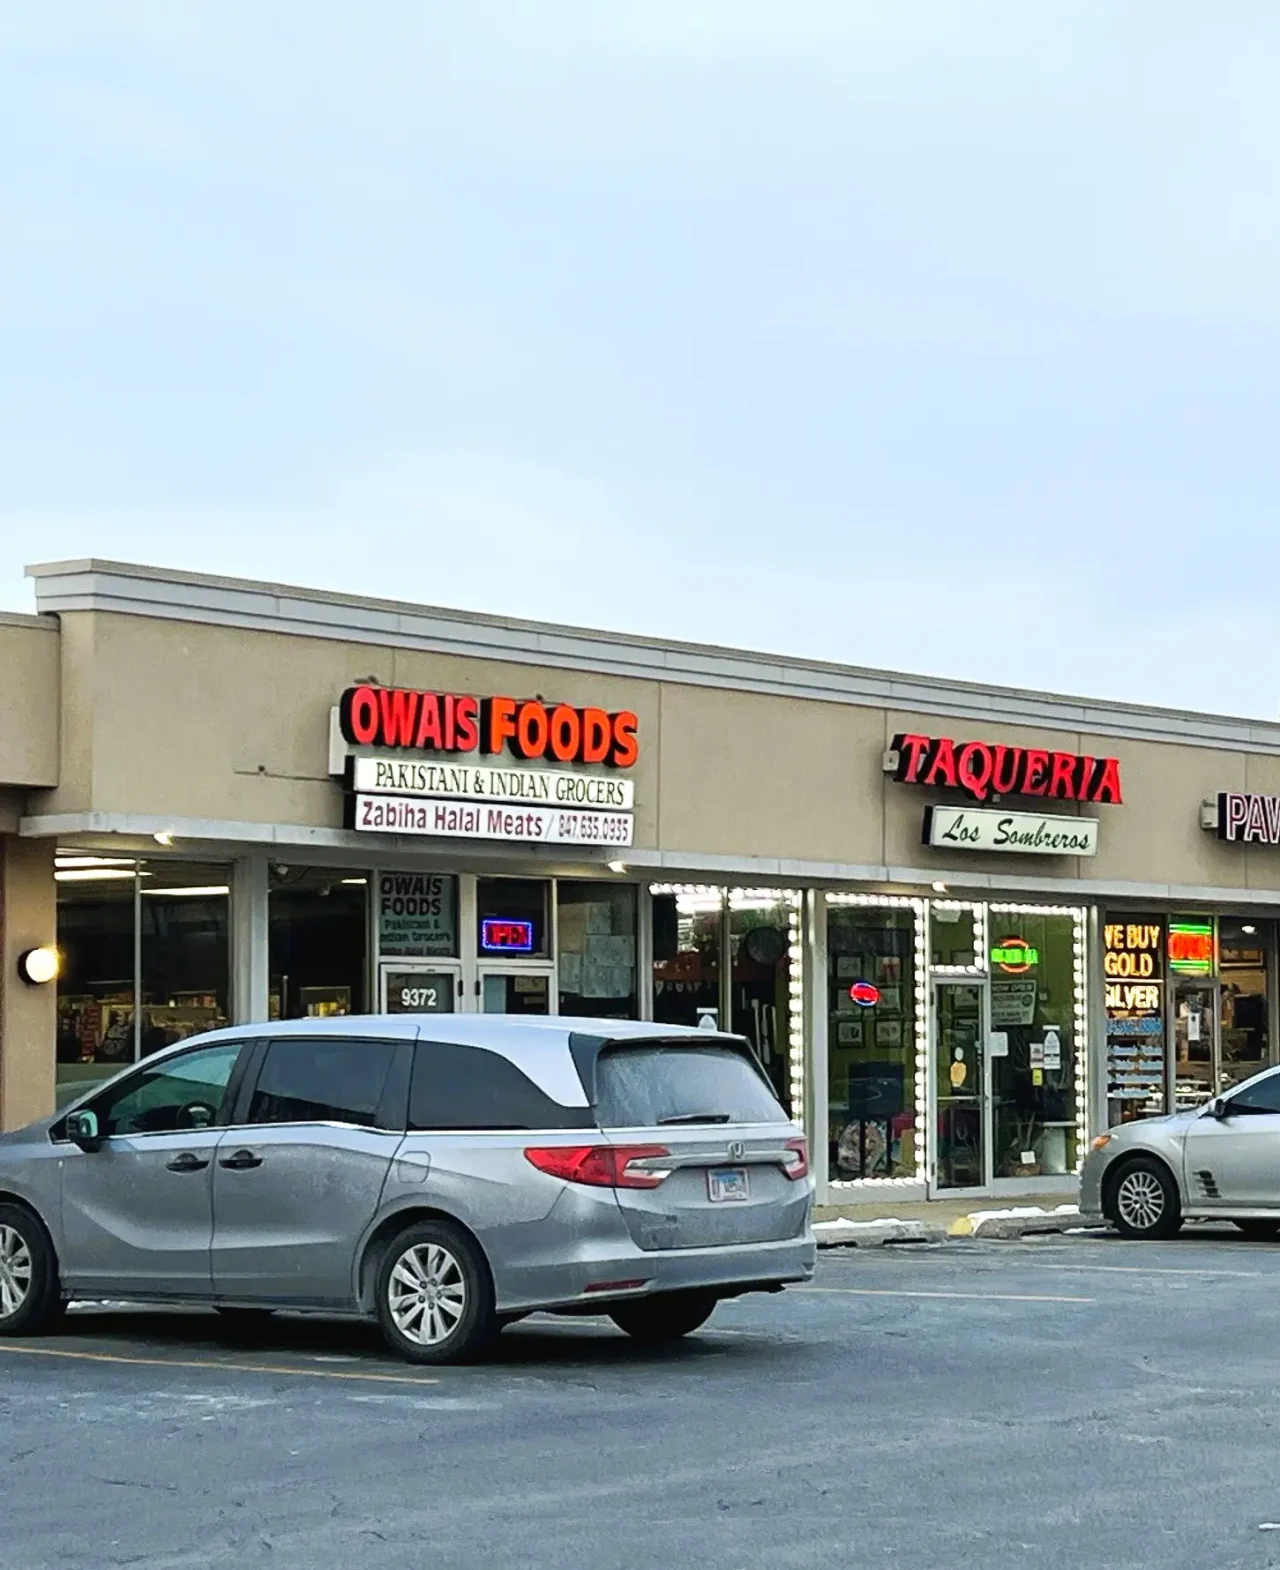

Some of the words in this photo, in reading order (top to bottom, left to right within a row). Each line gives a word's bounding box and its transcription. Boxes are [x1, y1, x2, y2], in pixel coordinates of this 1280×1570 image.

[351, 684, 478, 752] OWAIS
[490, 696, 639, 768] FOODS
[375, 761, 469, 794] PAKISTANI
[474, 770, 485, 795] &
[489, 769, 550, 799] INDIAN
[555, 777, 625, 806] GROCERS
[901, 734, 1123, 804] TAQUERIA
[362, 800, 427, 829] Zabiha
[434, 805, 481, 833] Halal
[487, 809, 543, 838] Meats
[942, 813, 981, 842] Los
[992, 818, 1091, 851] Sombreros
[380, 876, 443, 896] OWAIS
[381, 897, 442, 916] FOODS
[1126, 924, 1160, 949] BUY
[1104, 951, 1153, 977] GOLD
[401, 988, 437, 1007] 9372
